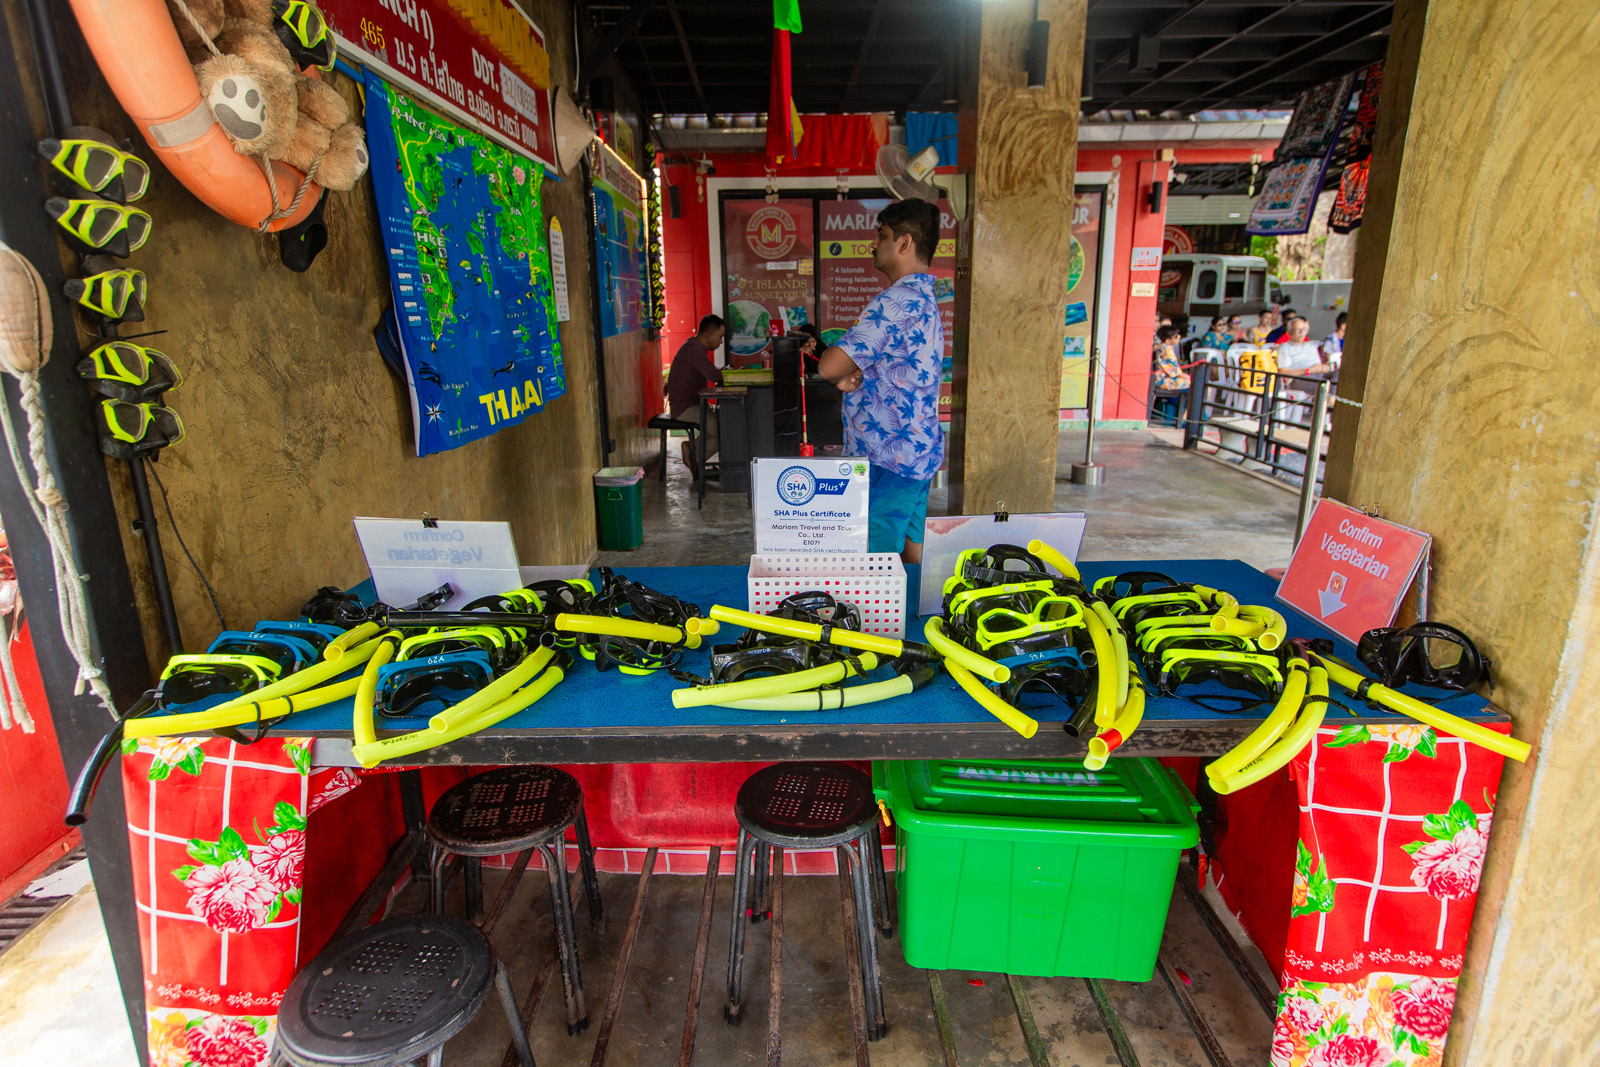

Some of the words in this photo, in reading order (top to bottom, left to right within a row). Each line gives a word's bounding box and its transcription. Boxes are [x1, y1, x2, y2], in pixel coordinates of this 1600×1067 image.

[360, 17, 386, 50] 465
[394, 37, 416, 74] ม.5
[826, 214, 881, 230] MARIA
[744, 290, 782, 299] SUNSET
[782, 290, 808, 299] TOUR
[756, 279, 808, 290] ISLANDS
[1339, 519, 1383, 549] Confirm
[1321, 533, 1390, 580] Vegetarian
[427, 656, 445, 665] Y29
